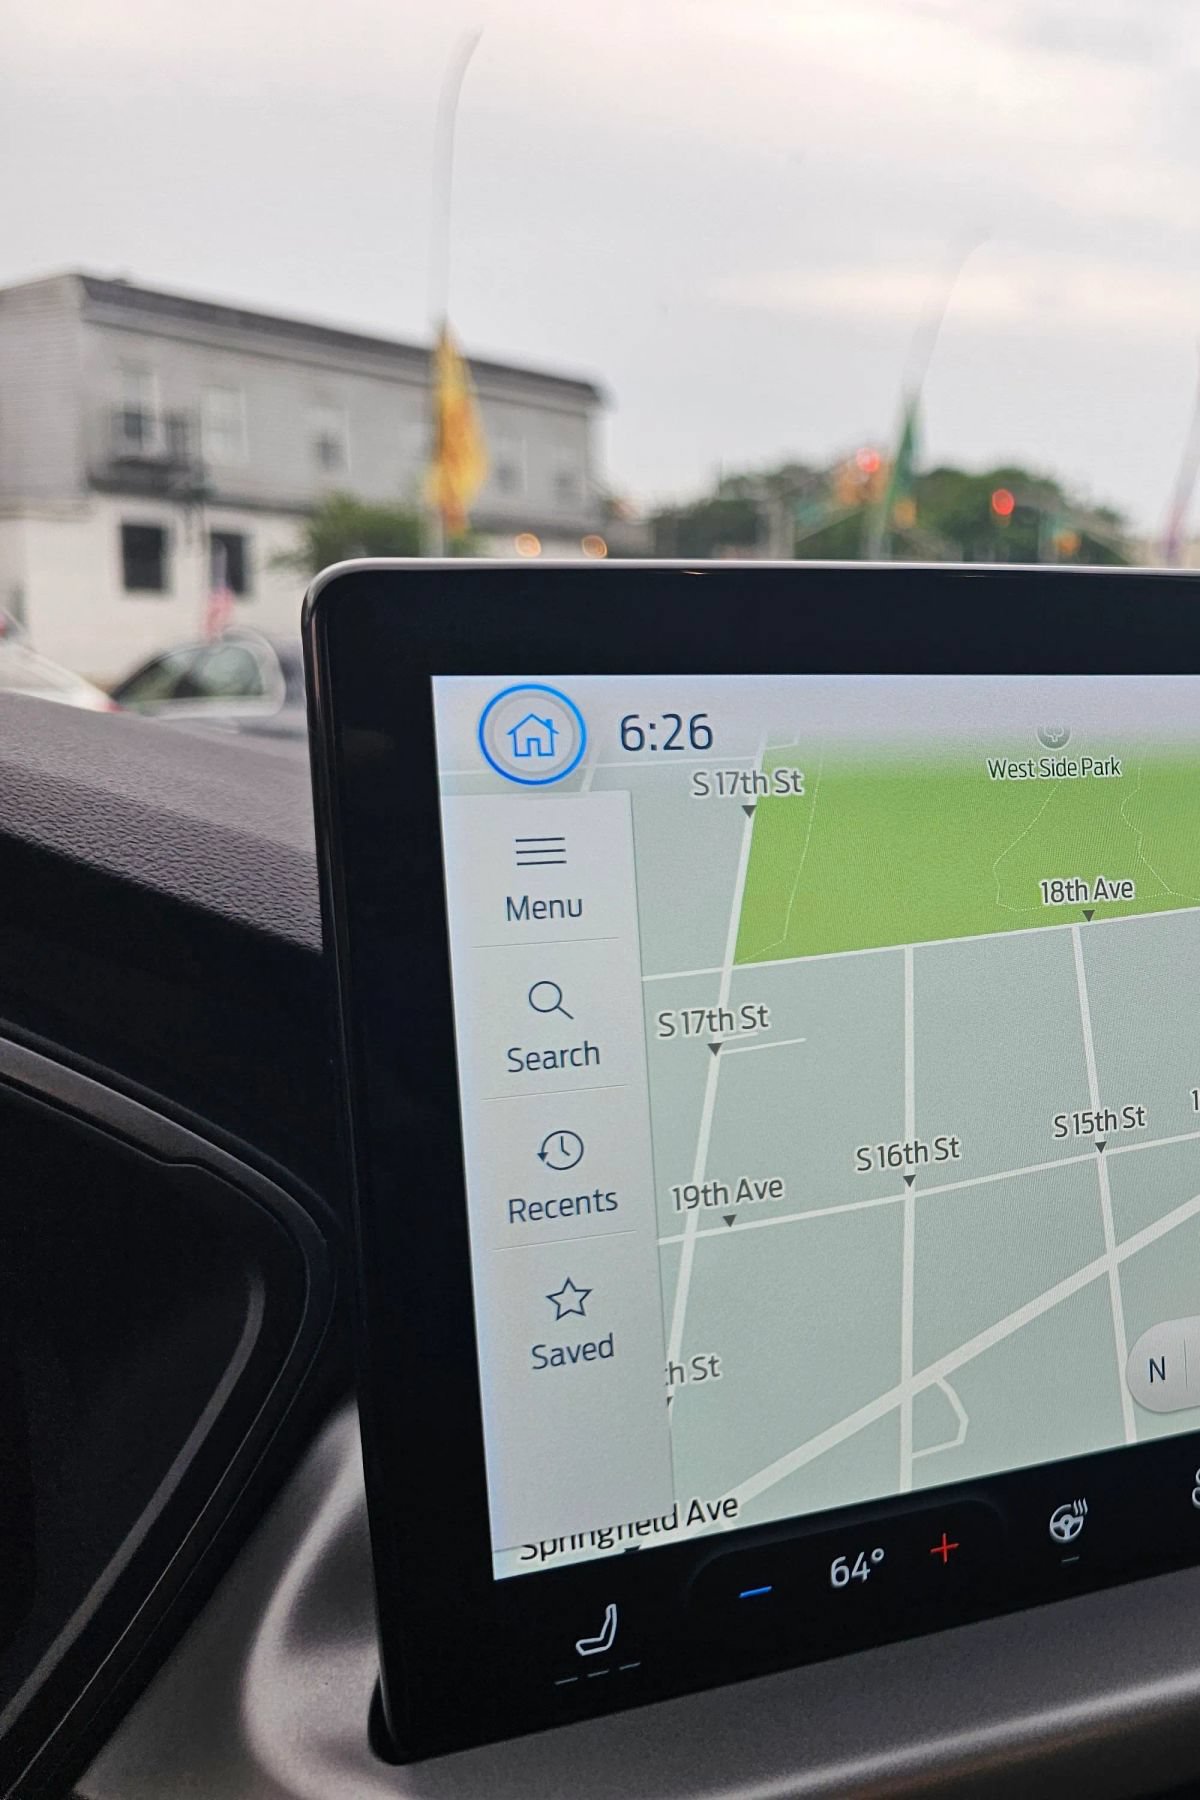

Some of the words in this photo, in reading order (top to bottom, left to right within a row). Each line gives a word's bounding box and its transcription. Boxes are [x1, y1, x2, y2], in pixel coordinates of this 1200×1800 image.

[620, 713, 714, 751] 6:26
[988, 759, 1036, 778] West
[1039, 758, 1078, 777] Side
[1081, 756, 1122, 776] Park
[692, 772, 708, 797] S
[716, 771, 768, 795] 17th
[774, 770, 802, 793] St
[1041, 879, 1089, 904] 18th
[1094, 878, 1135, 901] Ave
[506, 896, 584, 922] Menu
[658, 1013, 675, 1038] S
[681, 1009, 734, 1034] 17th
[740, 1006, 769, 1031] St
[507, 1040, 601, 1074] Search
[1054, 1116, 1068, 1138] S
[1073, 1110, 1118, 1135] 15th
[1121, 1106, 1146, 1130] St
[856, 1148, 872, 1172] S
[878, 1142, 929, 1169] 16th
[934, 1137, 961, 1161] St
[508, 1190, 619, 1224] Recents
[672, 1183, 729, 1212] 19th
[735, 1178, 784, 1203] Ave
[531, 1333, 615, 1370] Saved
[691, 1355, 721, 1381] St
[1148, 1356, 1167, 1383] N
[686, 1497, 738, 1527] Ave
[830, 1547, 886, 1588] 64°
